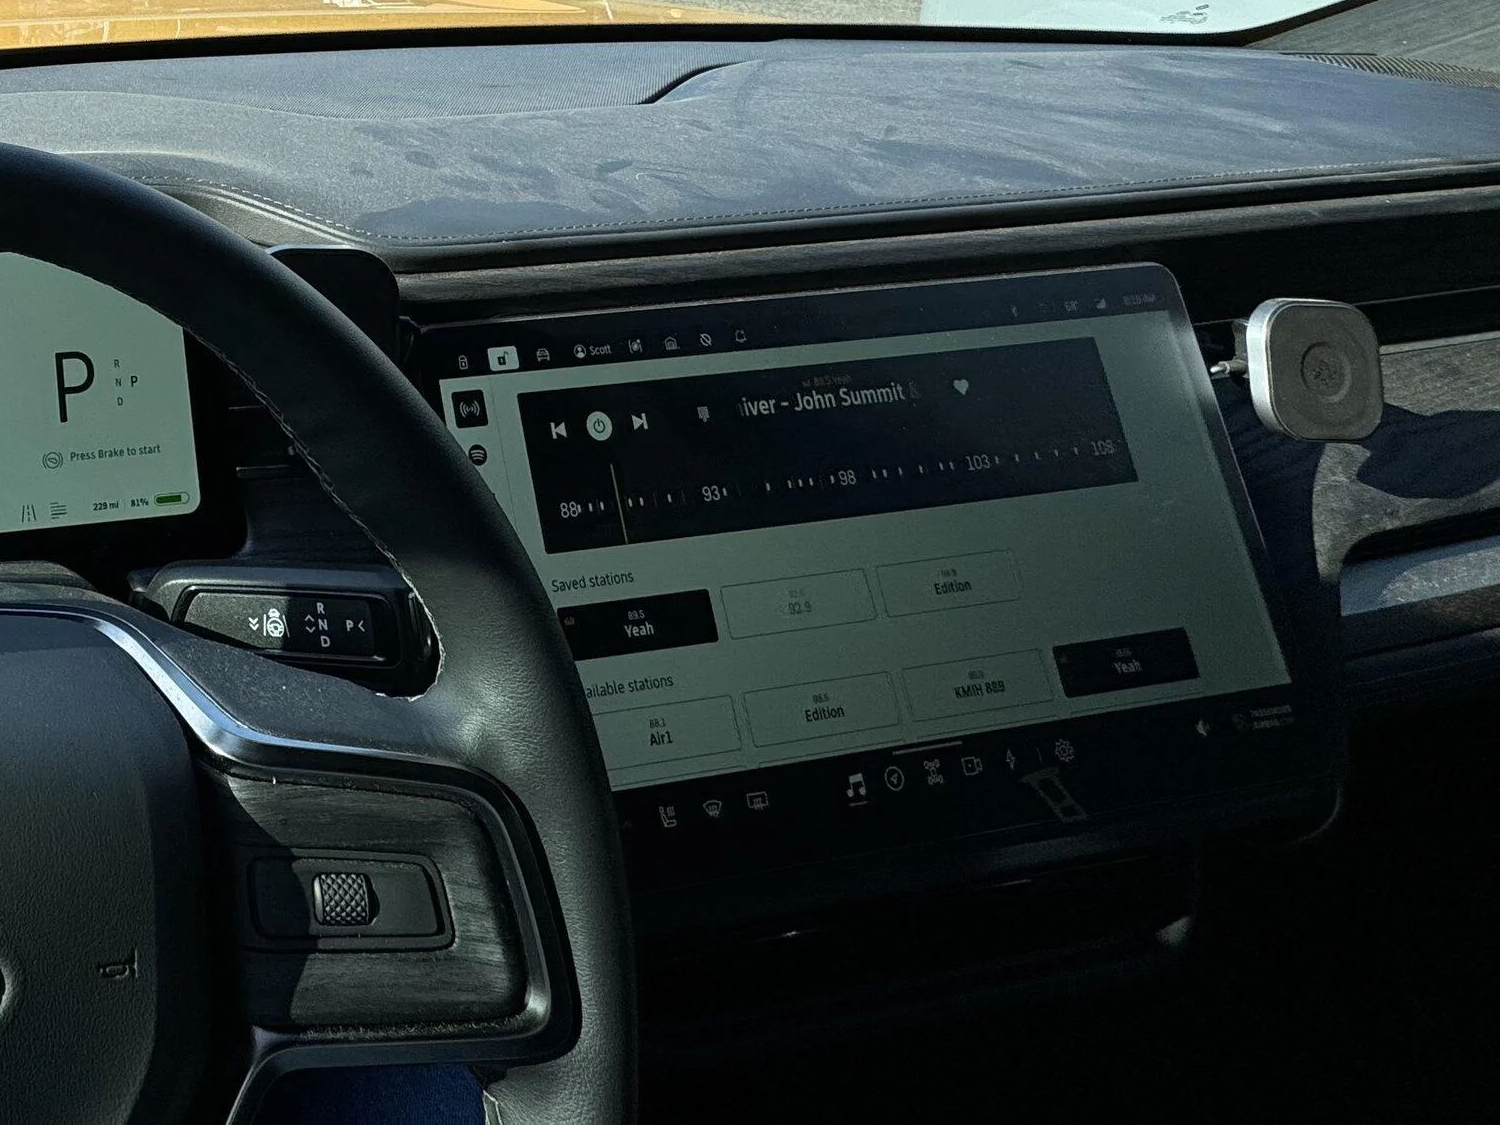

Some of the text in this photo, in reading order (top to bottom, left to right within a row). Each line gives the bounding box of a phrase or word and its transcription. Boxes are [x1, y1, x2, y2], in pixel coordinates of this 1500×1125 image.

[589, 341, 613, 357] Scott
[113, 359, 121, 368] R
[55, 351, 95, 423] P
[115, 378, 122, 387] N
[130, 375, 138, 387] P
[116, 397, 124, 406] D
[794, 391, 836, 412] John
[839, 382, 906, 407] Summit
[70, 444, 161, 461] Press Brake to start
[965, 454, 990, 471] 103
[838, 470, 856, 486] 98
[702, 485, 721, 502] 93
[93, 501, 119, 511] 229 mi
[130, 497, 149, 507] 81%
[559, 501, 579, 519] 88
[552, 571, 635, 593] Saved stations
[934, 579, 972, 595] Edition
[316, 602, 326, 614] R
[627, 609, 646, 620] 89.5
[318, 619, 328, 630] N
[345, 620, 354, 632] P
[624, 622, 654, 638] Yeah
[321, 636, 331, 648] D
[1112, 659, 1142, 675] Yeah
[586, 676, 675, 699] ailable stations
[954, 683, 984, 699] KMIH
[805, 706, 845, 723] Edition
[650, 731, 674, 747] Air1
